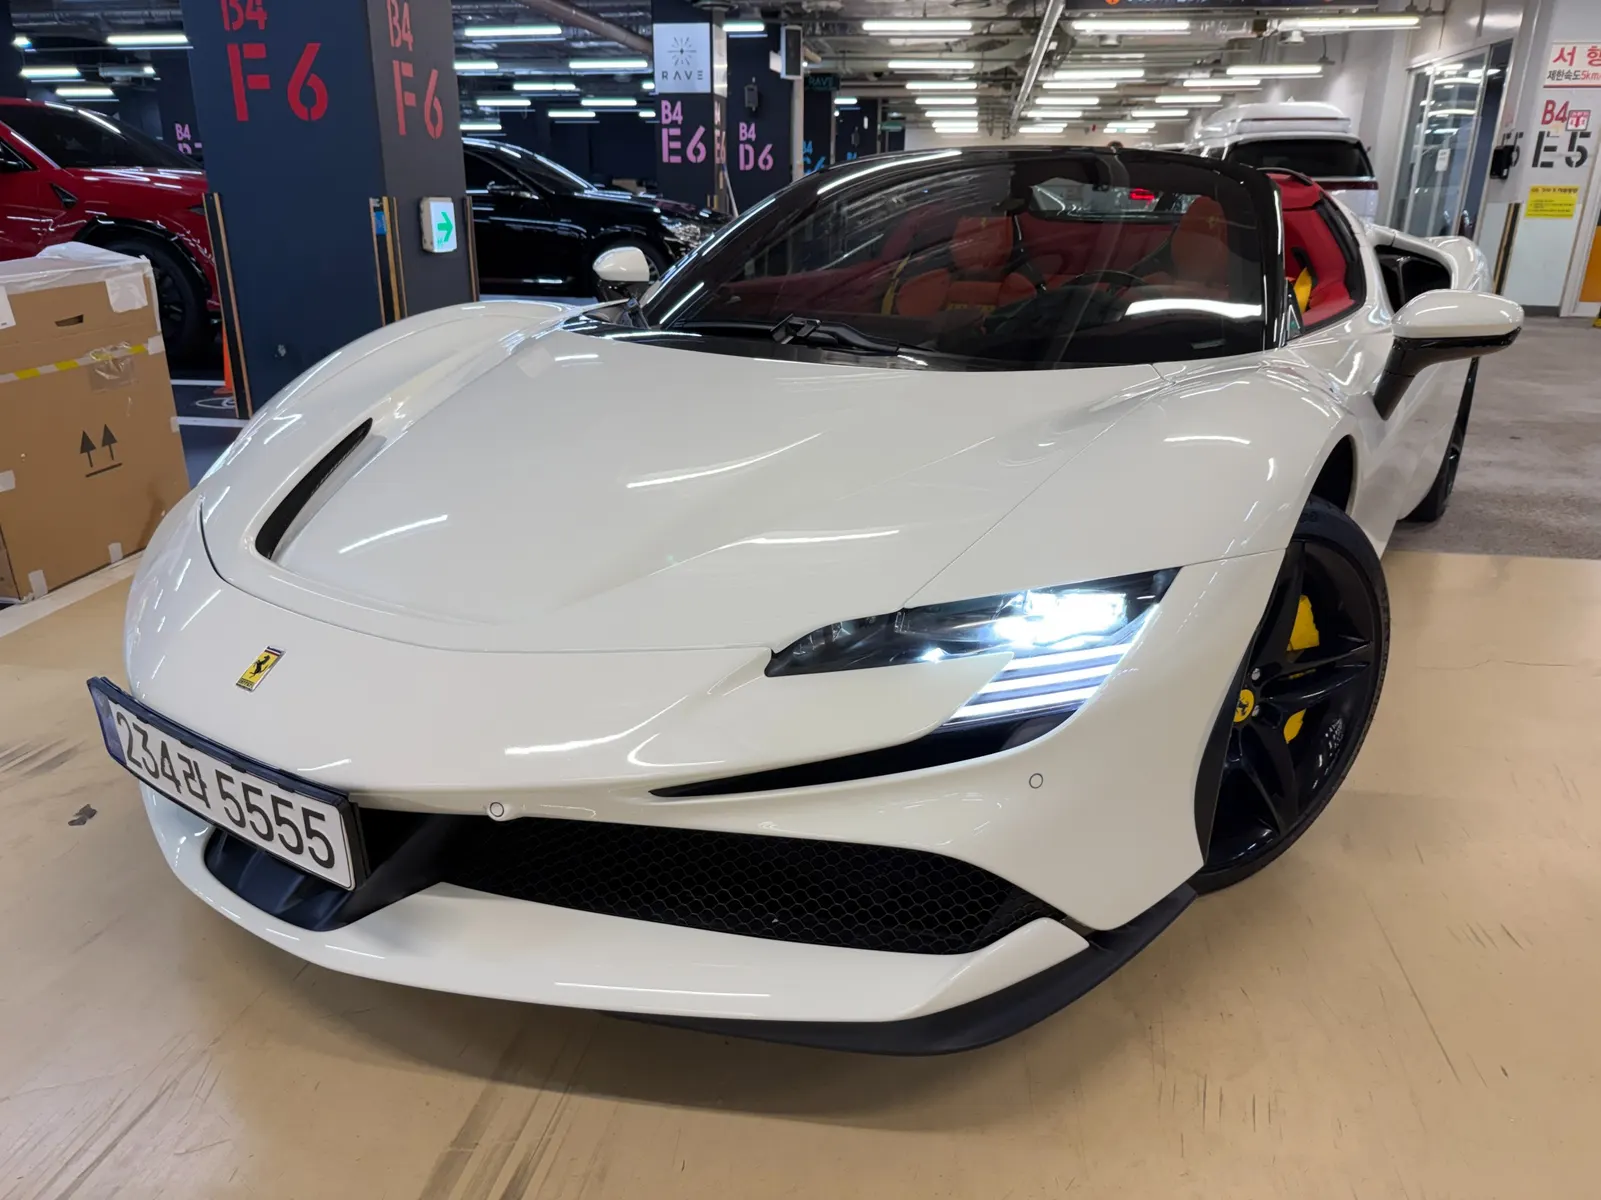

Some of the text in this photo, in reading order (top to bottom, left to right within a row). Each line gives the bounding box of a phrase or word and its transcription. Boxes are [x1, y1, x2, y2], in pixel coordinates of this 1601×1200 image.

[387, 0, 414, 51] B4
[661, 70, 703, 81] RAVE
[660, 99, 683, 125] B4
[1541, 99, 1569, 126] B4
[174, 122, 191, 141] B4
[661, 124, 707, 164] E6
[739, 121, 756, 142] B4
[739, 143, 774, 171] D6
[116, 711, 336, 870] 234라 5555
